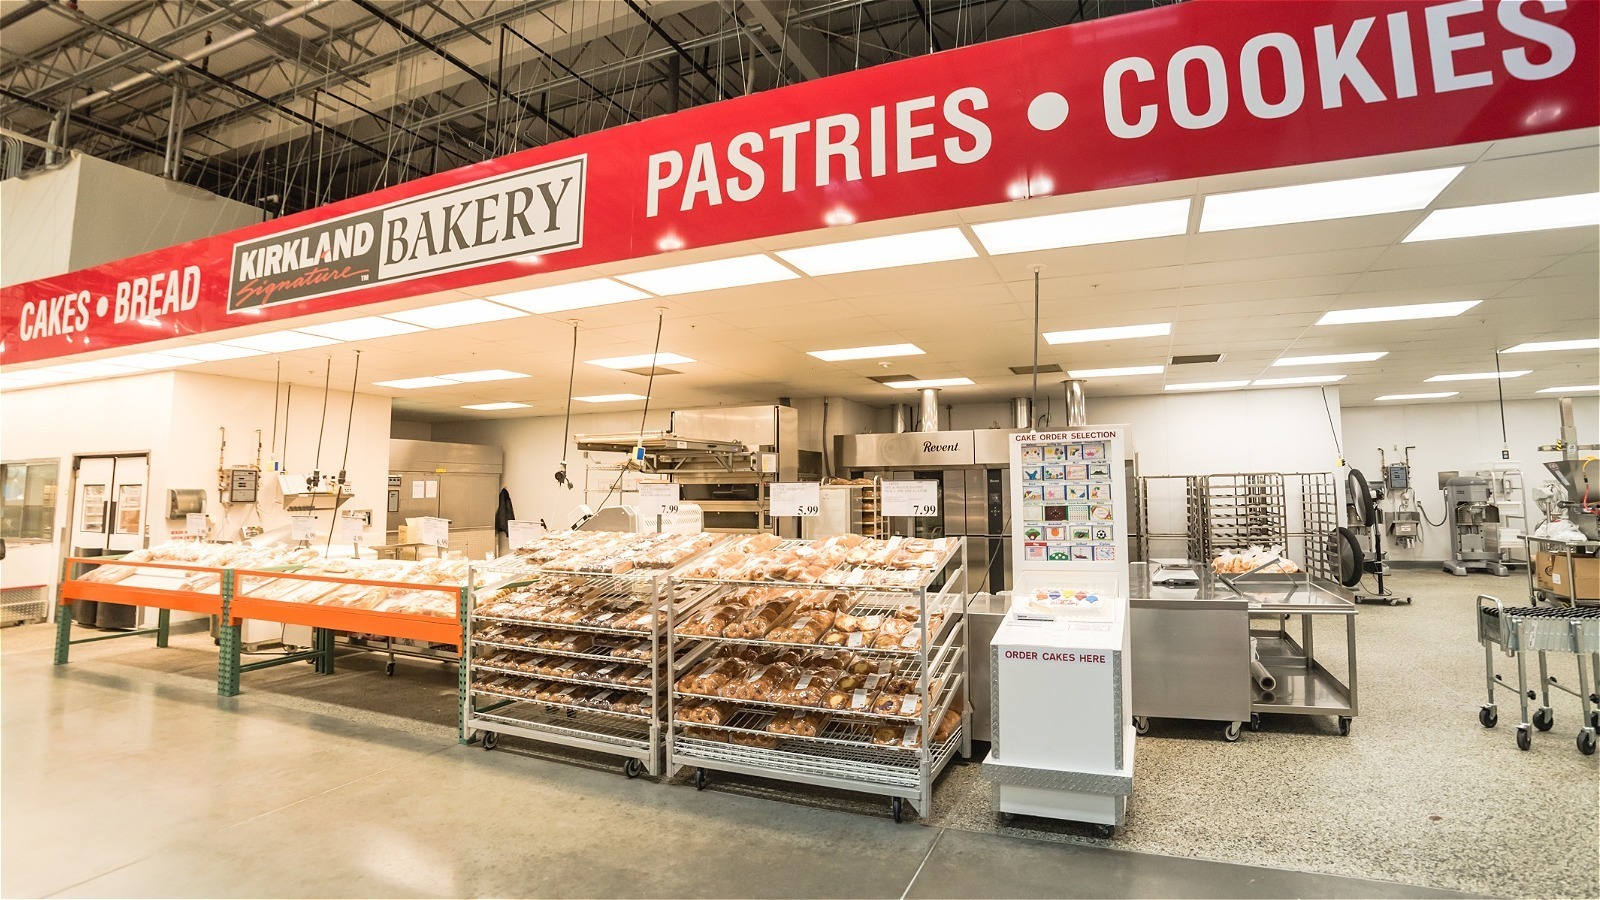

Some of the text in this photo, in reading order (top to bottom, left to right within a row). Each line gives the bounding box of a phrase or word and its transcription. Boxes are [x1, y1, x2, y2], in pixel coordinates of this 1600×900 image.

[645, 0, 1577, 218] PASTRIES COOKIES
[239, 176, 574, 282] KIRKLAND BAKERY
[235, 265, 370, 307] Signature
[19, 265, 202, 342] CAKES BREAD
[1015, 431, 1117, 442] CAKE ORDER SELECTION
[922, 440, 959, 453] Revent
[661, 504, 679, 514] 7.99
[797, 505, 819, 516] 5.99
[912, 504, 937, 515] 7.99
[1004, 650, 1106, 664] ORDER CAKES HERE
